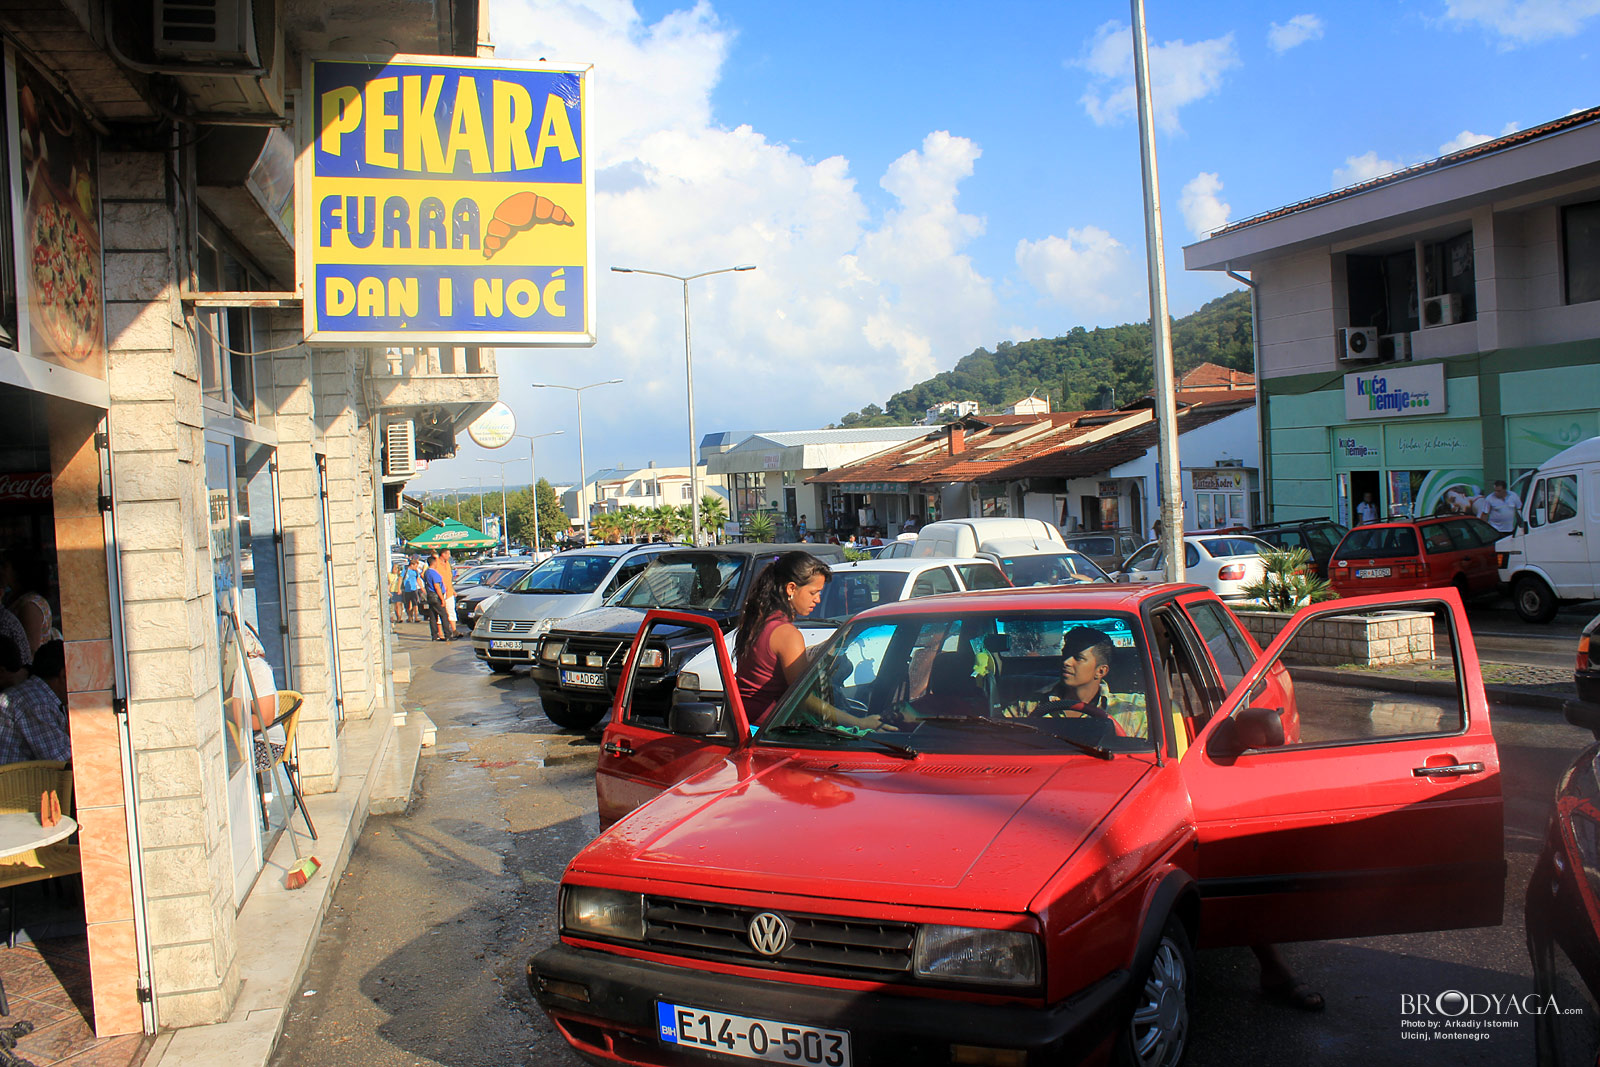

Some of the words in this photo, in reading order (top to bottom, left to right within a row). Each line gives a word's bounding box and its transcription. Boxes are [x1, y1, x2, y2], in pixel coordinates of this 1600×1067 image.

[321, 74, 581, 174] PEKARA
[319, 195, 481, 250] FURRA
[325, 276, 419, 318] DAN
[438, 277, 453, 317] I
[473, 267, 566, 318] NOĆ
[1356, 375, 1387, 395] kuća
